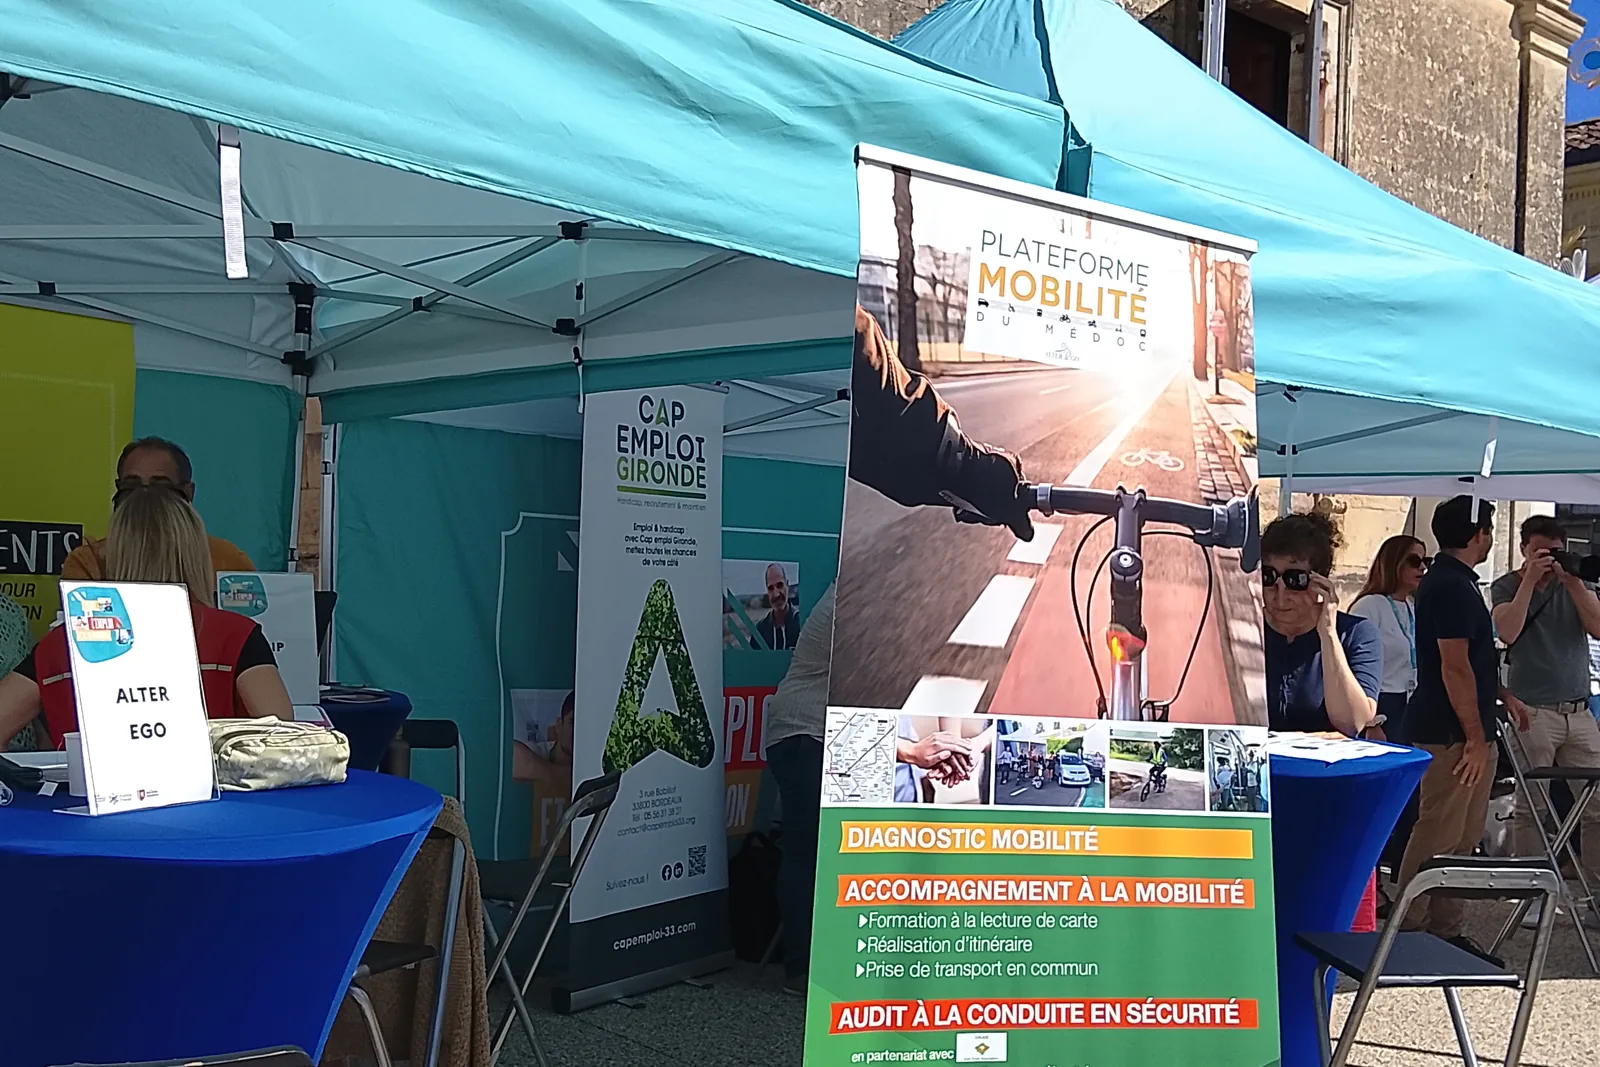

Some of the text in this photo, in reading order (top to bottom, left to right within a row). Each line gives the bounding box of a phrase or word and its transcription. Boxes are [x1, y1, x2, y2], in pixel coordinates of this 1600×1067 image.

[981, 229, 1149, 287] PLATEFORME
[978, 262, 1147, 325] MOBILITÉ
[976, 311, 1146, 351] DU MÉDOC
[638, 394, 685, 428] CAP
[617, 424, 706, 464] EMPLOI
[616, 456, 707, 489] GIRONDE
[624, 535, 639, 543] avec
[640, 535, 653, 544] Cap
[642, 558, 651, 566] de
[672, 548, 697, 557] chances
[0, 582, 36, 598] OUR
[116, 686, 170, 704] ALTER
[129, 722, 167, 740] EGO
[723, 694, 770, 763] PL
[847, 826, 1099, 851] DIAGNOSTIC MOBILITÉ
[844, 876, 1245, 904] ACCOMPAGNEMENT À LA MOBILITÉ
[868, 911, 1098, 928] Formation à la lecture de carte
[613, 921, 697, 950] capemploi-33.com
[867, 936, 1033, 953] Réalisation d'itinéraire
[865, 961, 1099, 980] Prise de transport en commun
[837, 998, 1240, 1030] AUDIT À LA CONDUITE EN SÉCURITÉ
[851, 1052, 864, 1063] en
[867, 1049, 927, 1064] partenariat
[929, 1050, 955, 1060] avec
